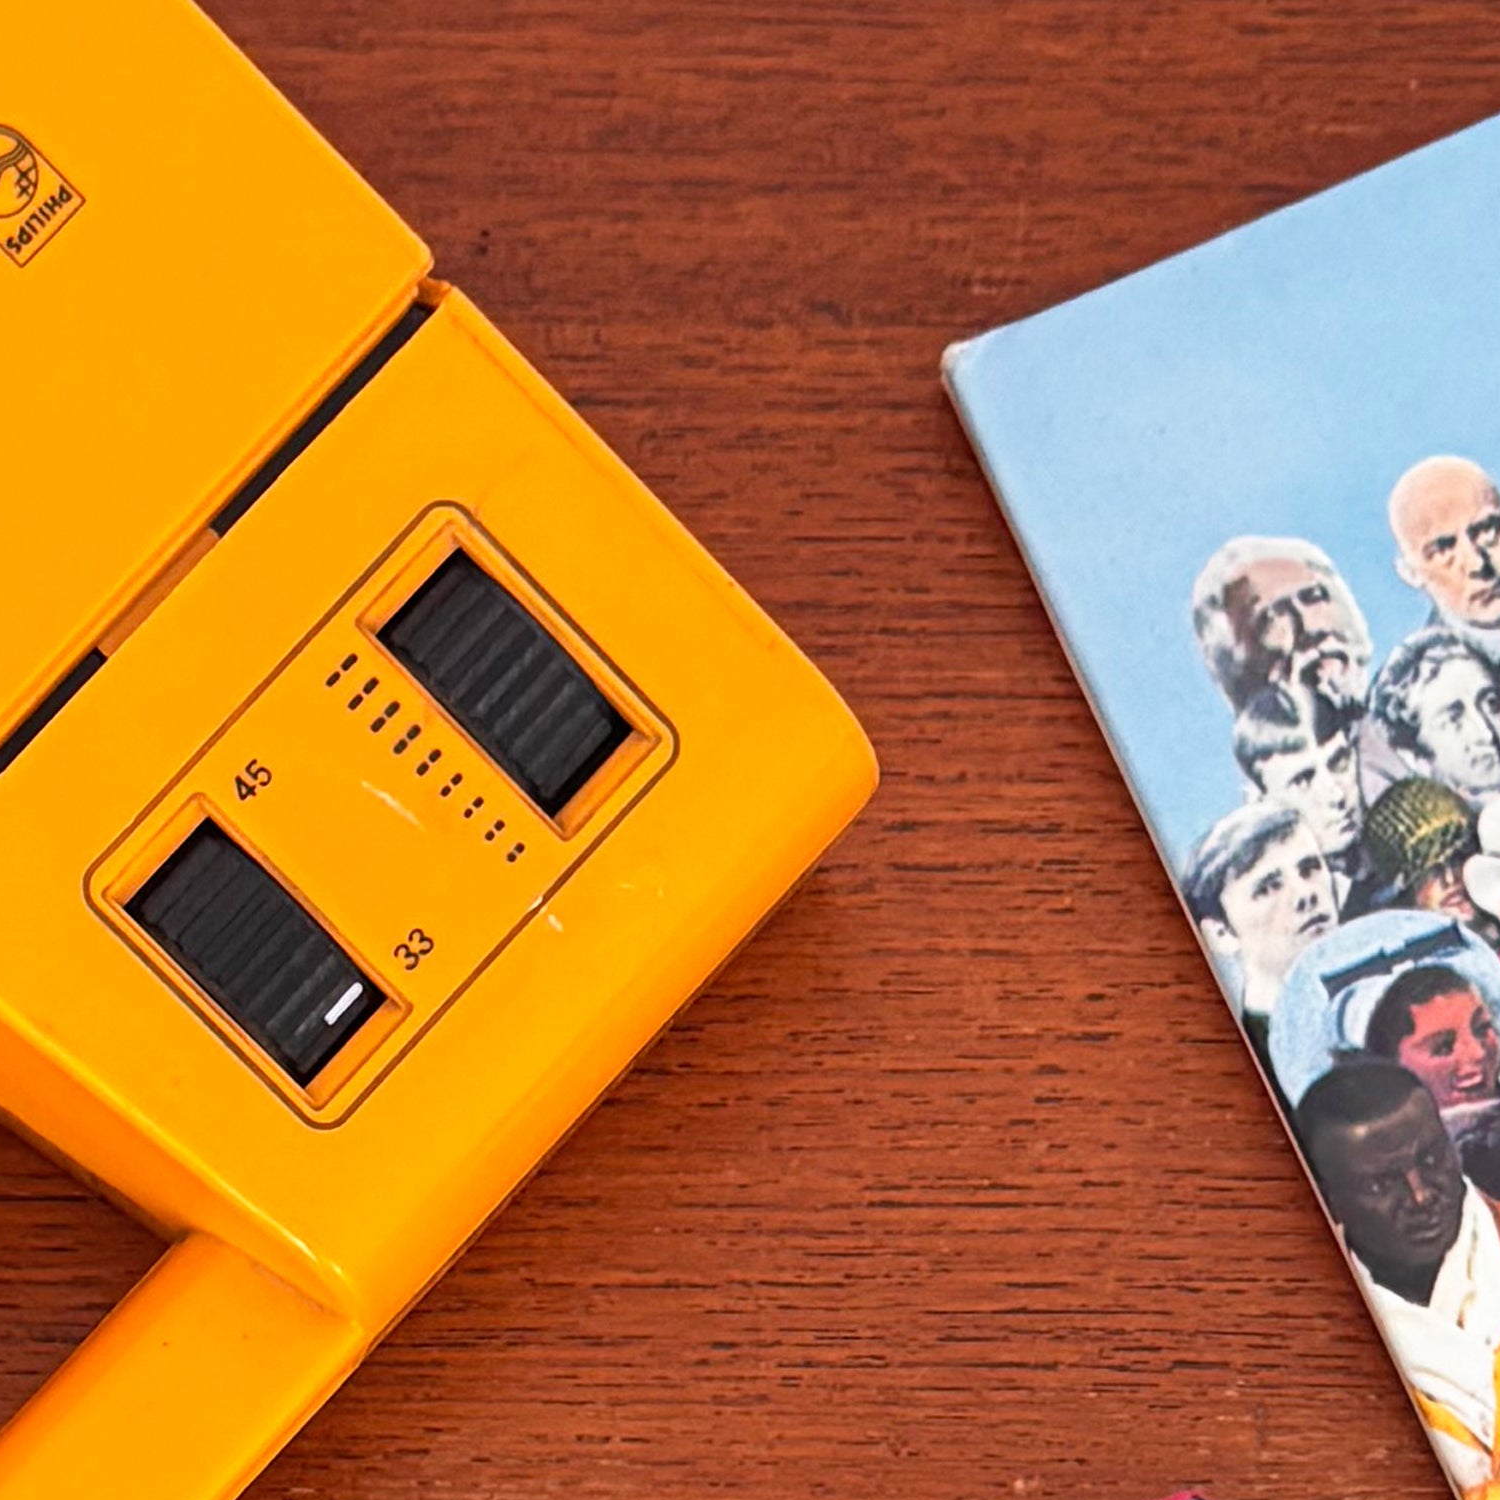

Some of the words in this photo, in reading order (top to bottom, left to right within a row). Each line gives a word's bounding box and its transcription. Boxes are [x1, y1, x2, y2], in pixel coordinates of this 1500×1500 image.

[5, 184, 73, 255] PHILIPS
[232, 758, 274, 803] 45
[393, 927, 435, 972] 33
